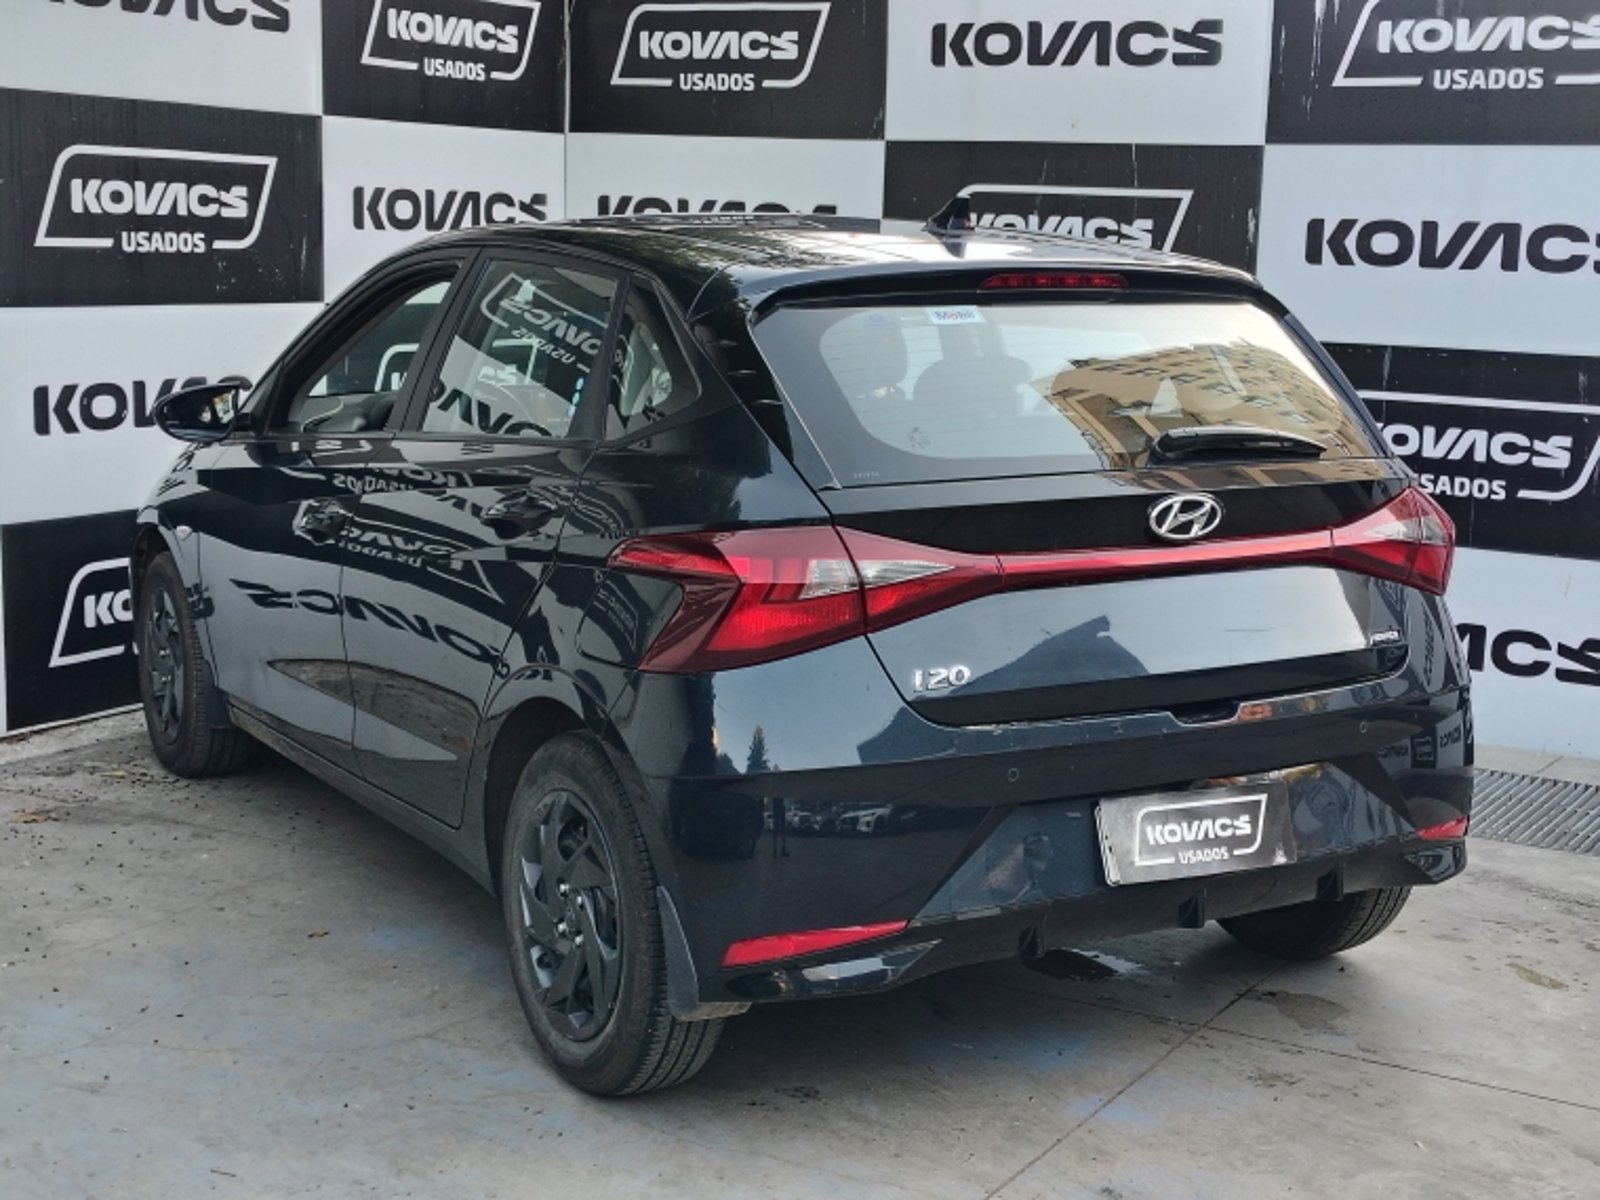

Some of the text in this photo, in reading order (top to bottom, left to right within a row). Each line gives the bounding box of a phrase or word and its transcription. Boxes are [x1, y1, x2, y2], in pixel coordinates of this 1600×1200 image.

[387, 8, 519, 53] KOVACS
[640, 30, 799, 60] KOVACS
[931, 19, 1223, 67] KOVACS
[1377, 15, 1600, 54] KOVACS
[424, 58, 486, 81] USADOS
[680, 73, 755, 92] USADOS
[1433, 67, 1544, 90] USADOS
[71, 178, 249, 218] KOVACS
[353, 186, 548, 231] KOVACS
[121, 231, 206, 254] USADOS
[1304, 218, 1600, 274] KOVAC
[33, 375, 253, 436] KOV
[1376, 422, 1573, 468] OVACS
[1413, 473, 1507, 500] SADOS
[1456, 622, 1600, 687] ACS
[1146, 814, 1253, 846] KOVACS
[1178, 846, 1230, 865] USADOS
